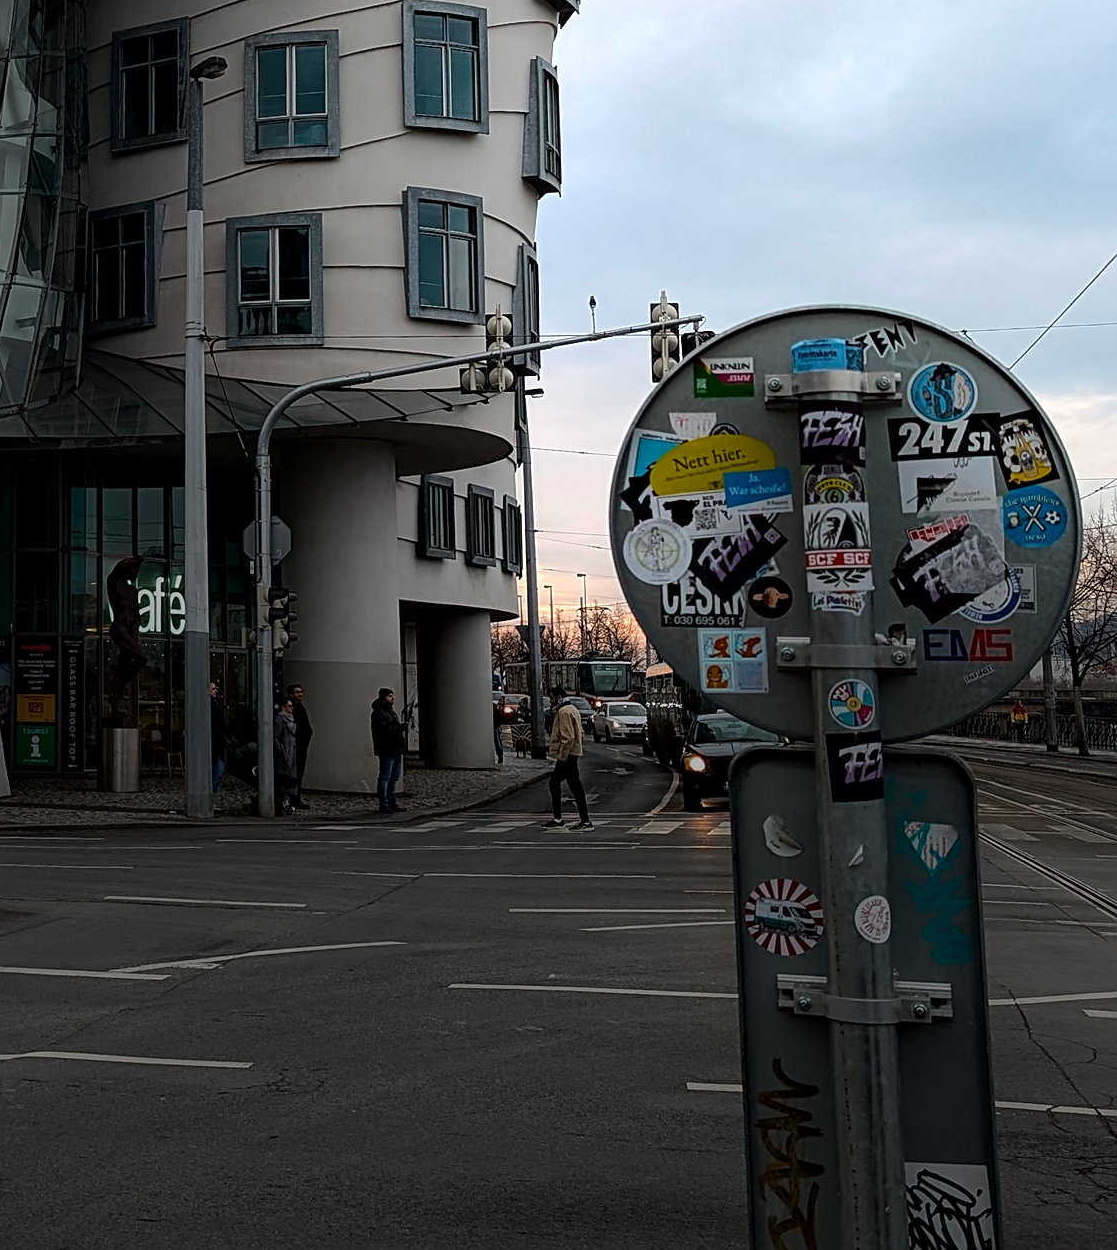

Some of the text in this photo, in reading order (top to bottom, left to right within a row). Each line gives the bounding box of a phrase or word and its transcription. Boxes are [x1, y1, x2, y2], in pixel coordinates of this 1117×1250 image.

[897, 419, 970, 456] 247
[672, 455, 710, 472] Nett
[711, 449, 746, 464] hier.
[728, 482, 787, 496] War scheiße!
[808, 552, 870, 566] SCF SCF
[663, 614, 672, 625] T:
[674, 616, 693, 626] 030
[695, 616, 715, 626] 695
[716, 616, 735, 626] 061
[68, 656, 77, 686] GLASS
[69, 689, 77, 709] BAR
[68, 711, 77, 739] ROOF
